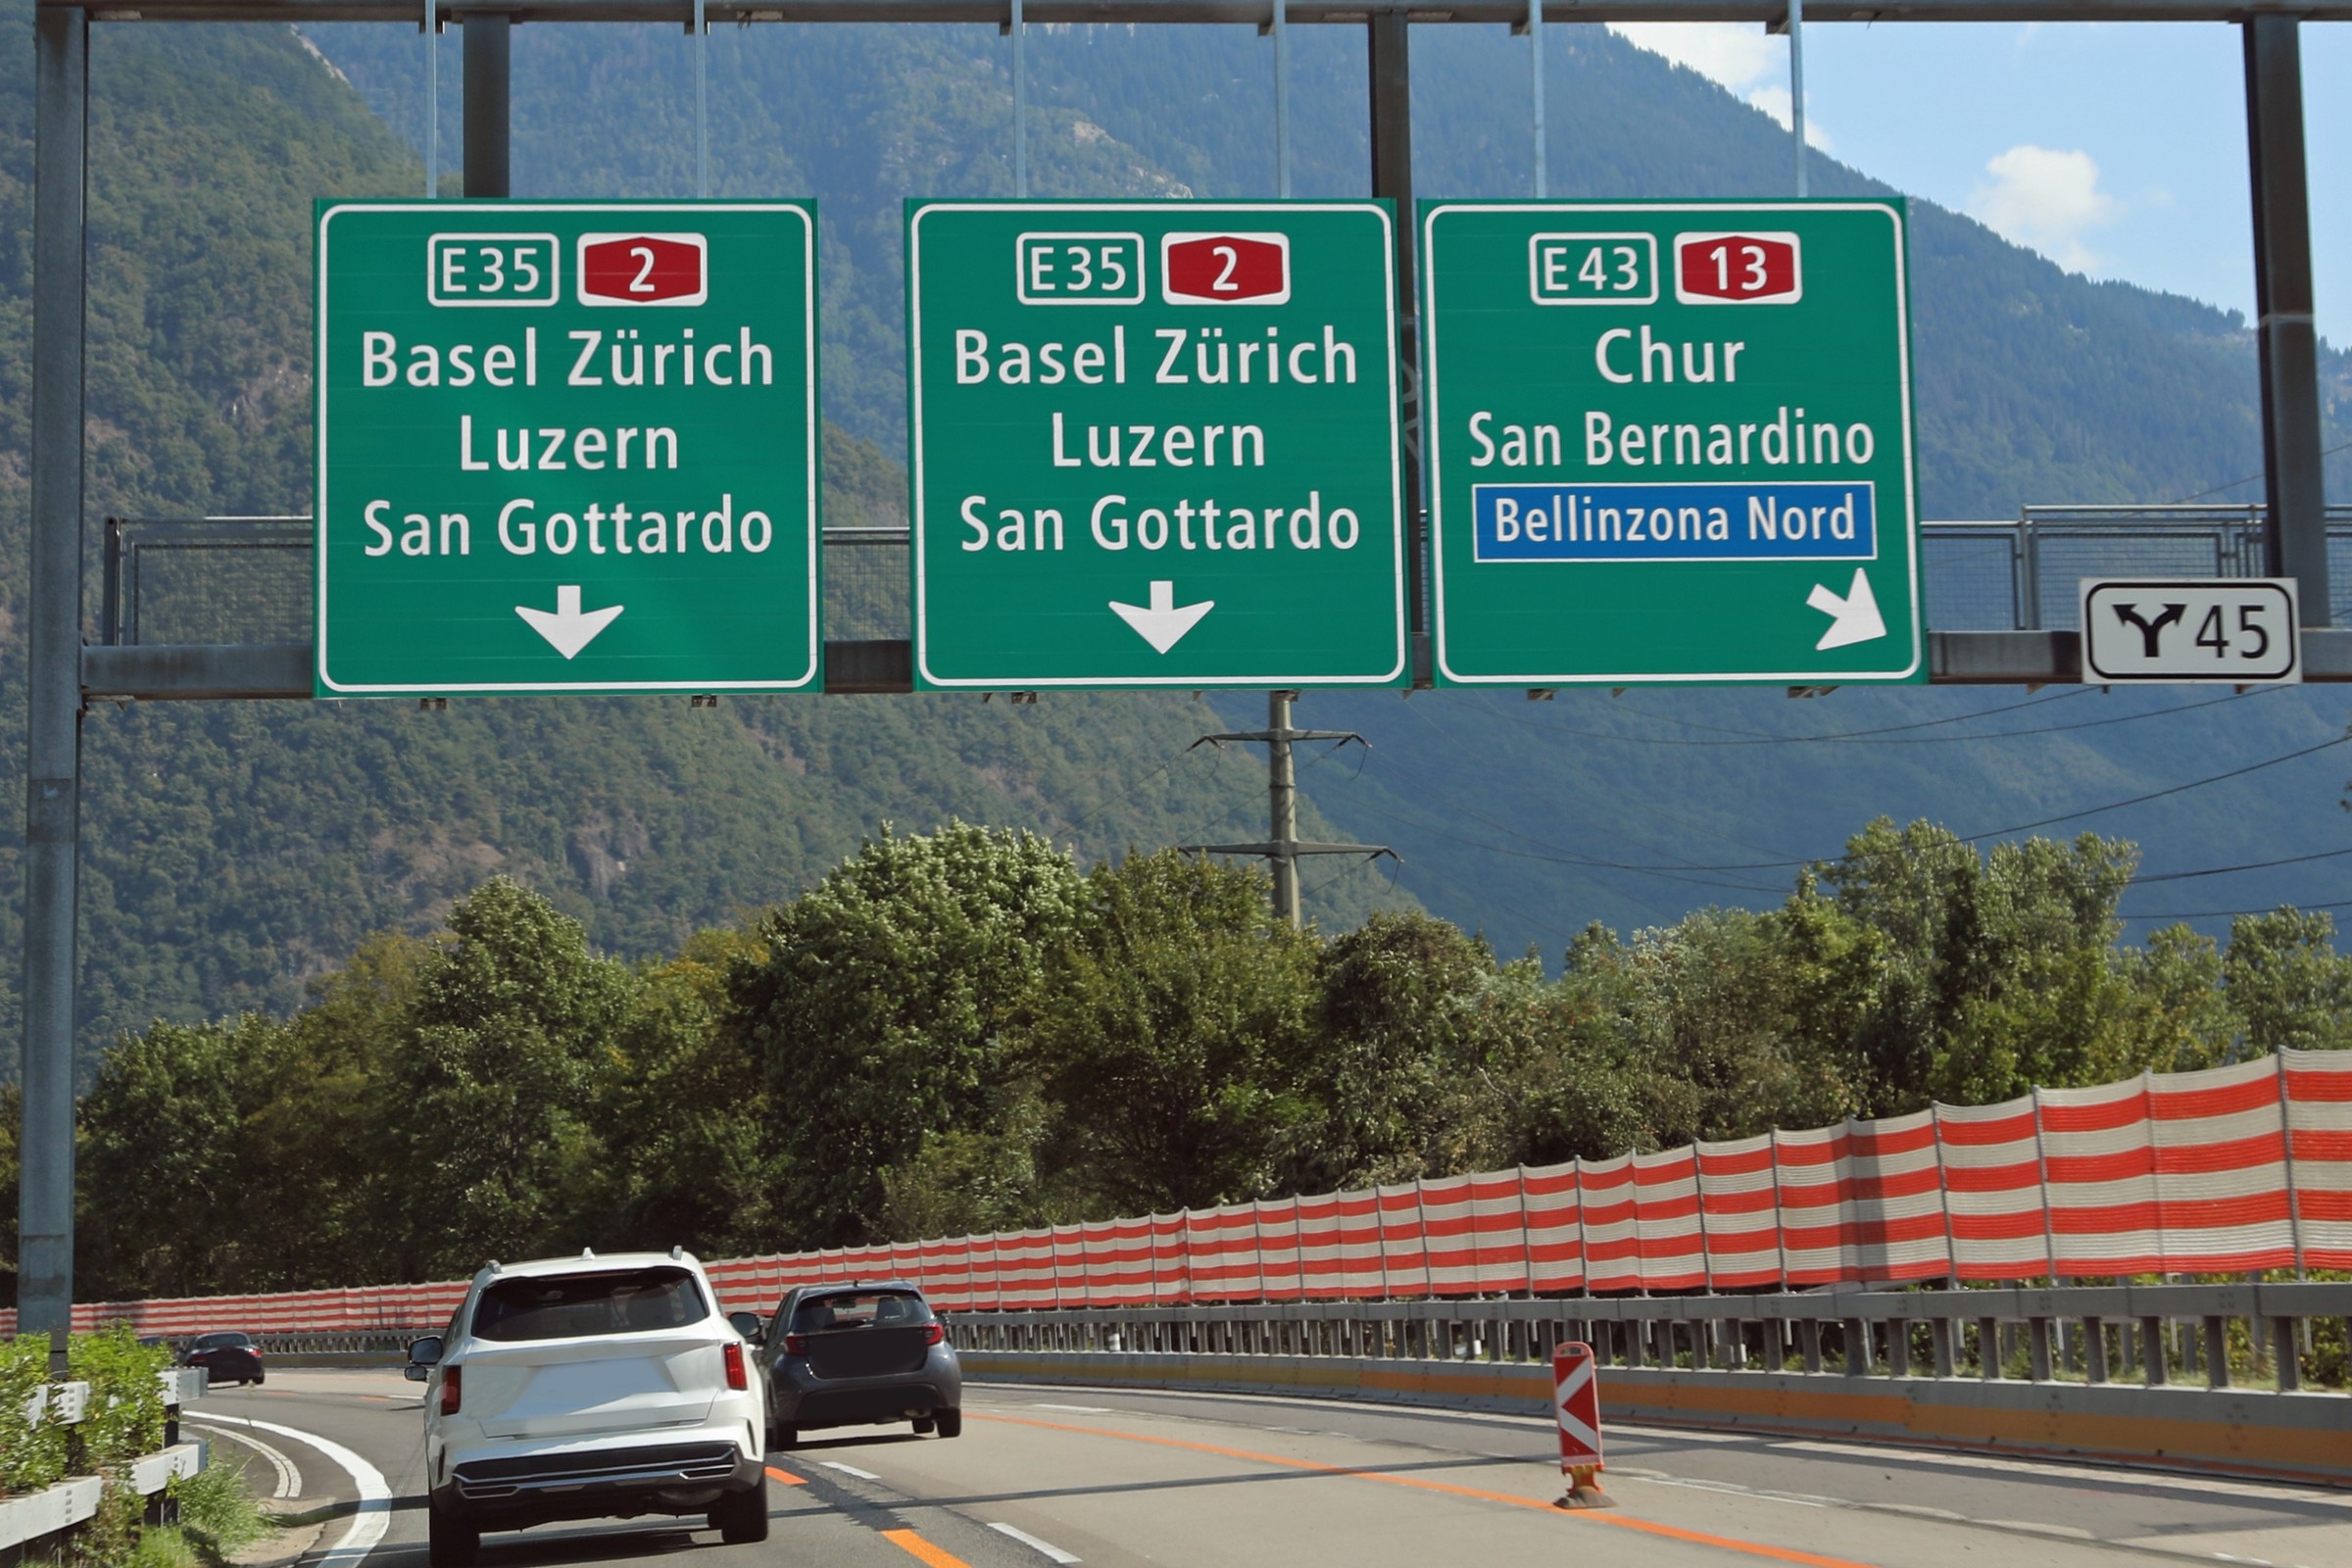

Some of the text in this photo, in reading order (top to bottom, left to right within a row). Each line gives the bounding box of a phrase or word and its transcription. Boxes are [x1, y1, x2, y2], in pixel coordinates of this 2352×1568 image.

[629, 247, 655, 292] 2
[1212, 246, 1239, 291] 2
[1710, 245, 1767, 291] 13
[363, 326, 772, 387] Basel Zürich
[956, 324, 1356, 384] Basel Zürich
[1595, 324, 1744, 383] Chur
[461, 415, 677, 470] Luzern
[1053, 412, 1264, 466] Luzern
[1469, 406, 1874, 466] San Bernardino
[364, 493, 772, 557] San Gottardo
[960, 490, 1359, 552] San Gottardo
[1495, 492, 1854, 542] Bellinzona Nord
[2195, 605, 2268, 659] 45
